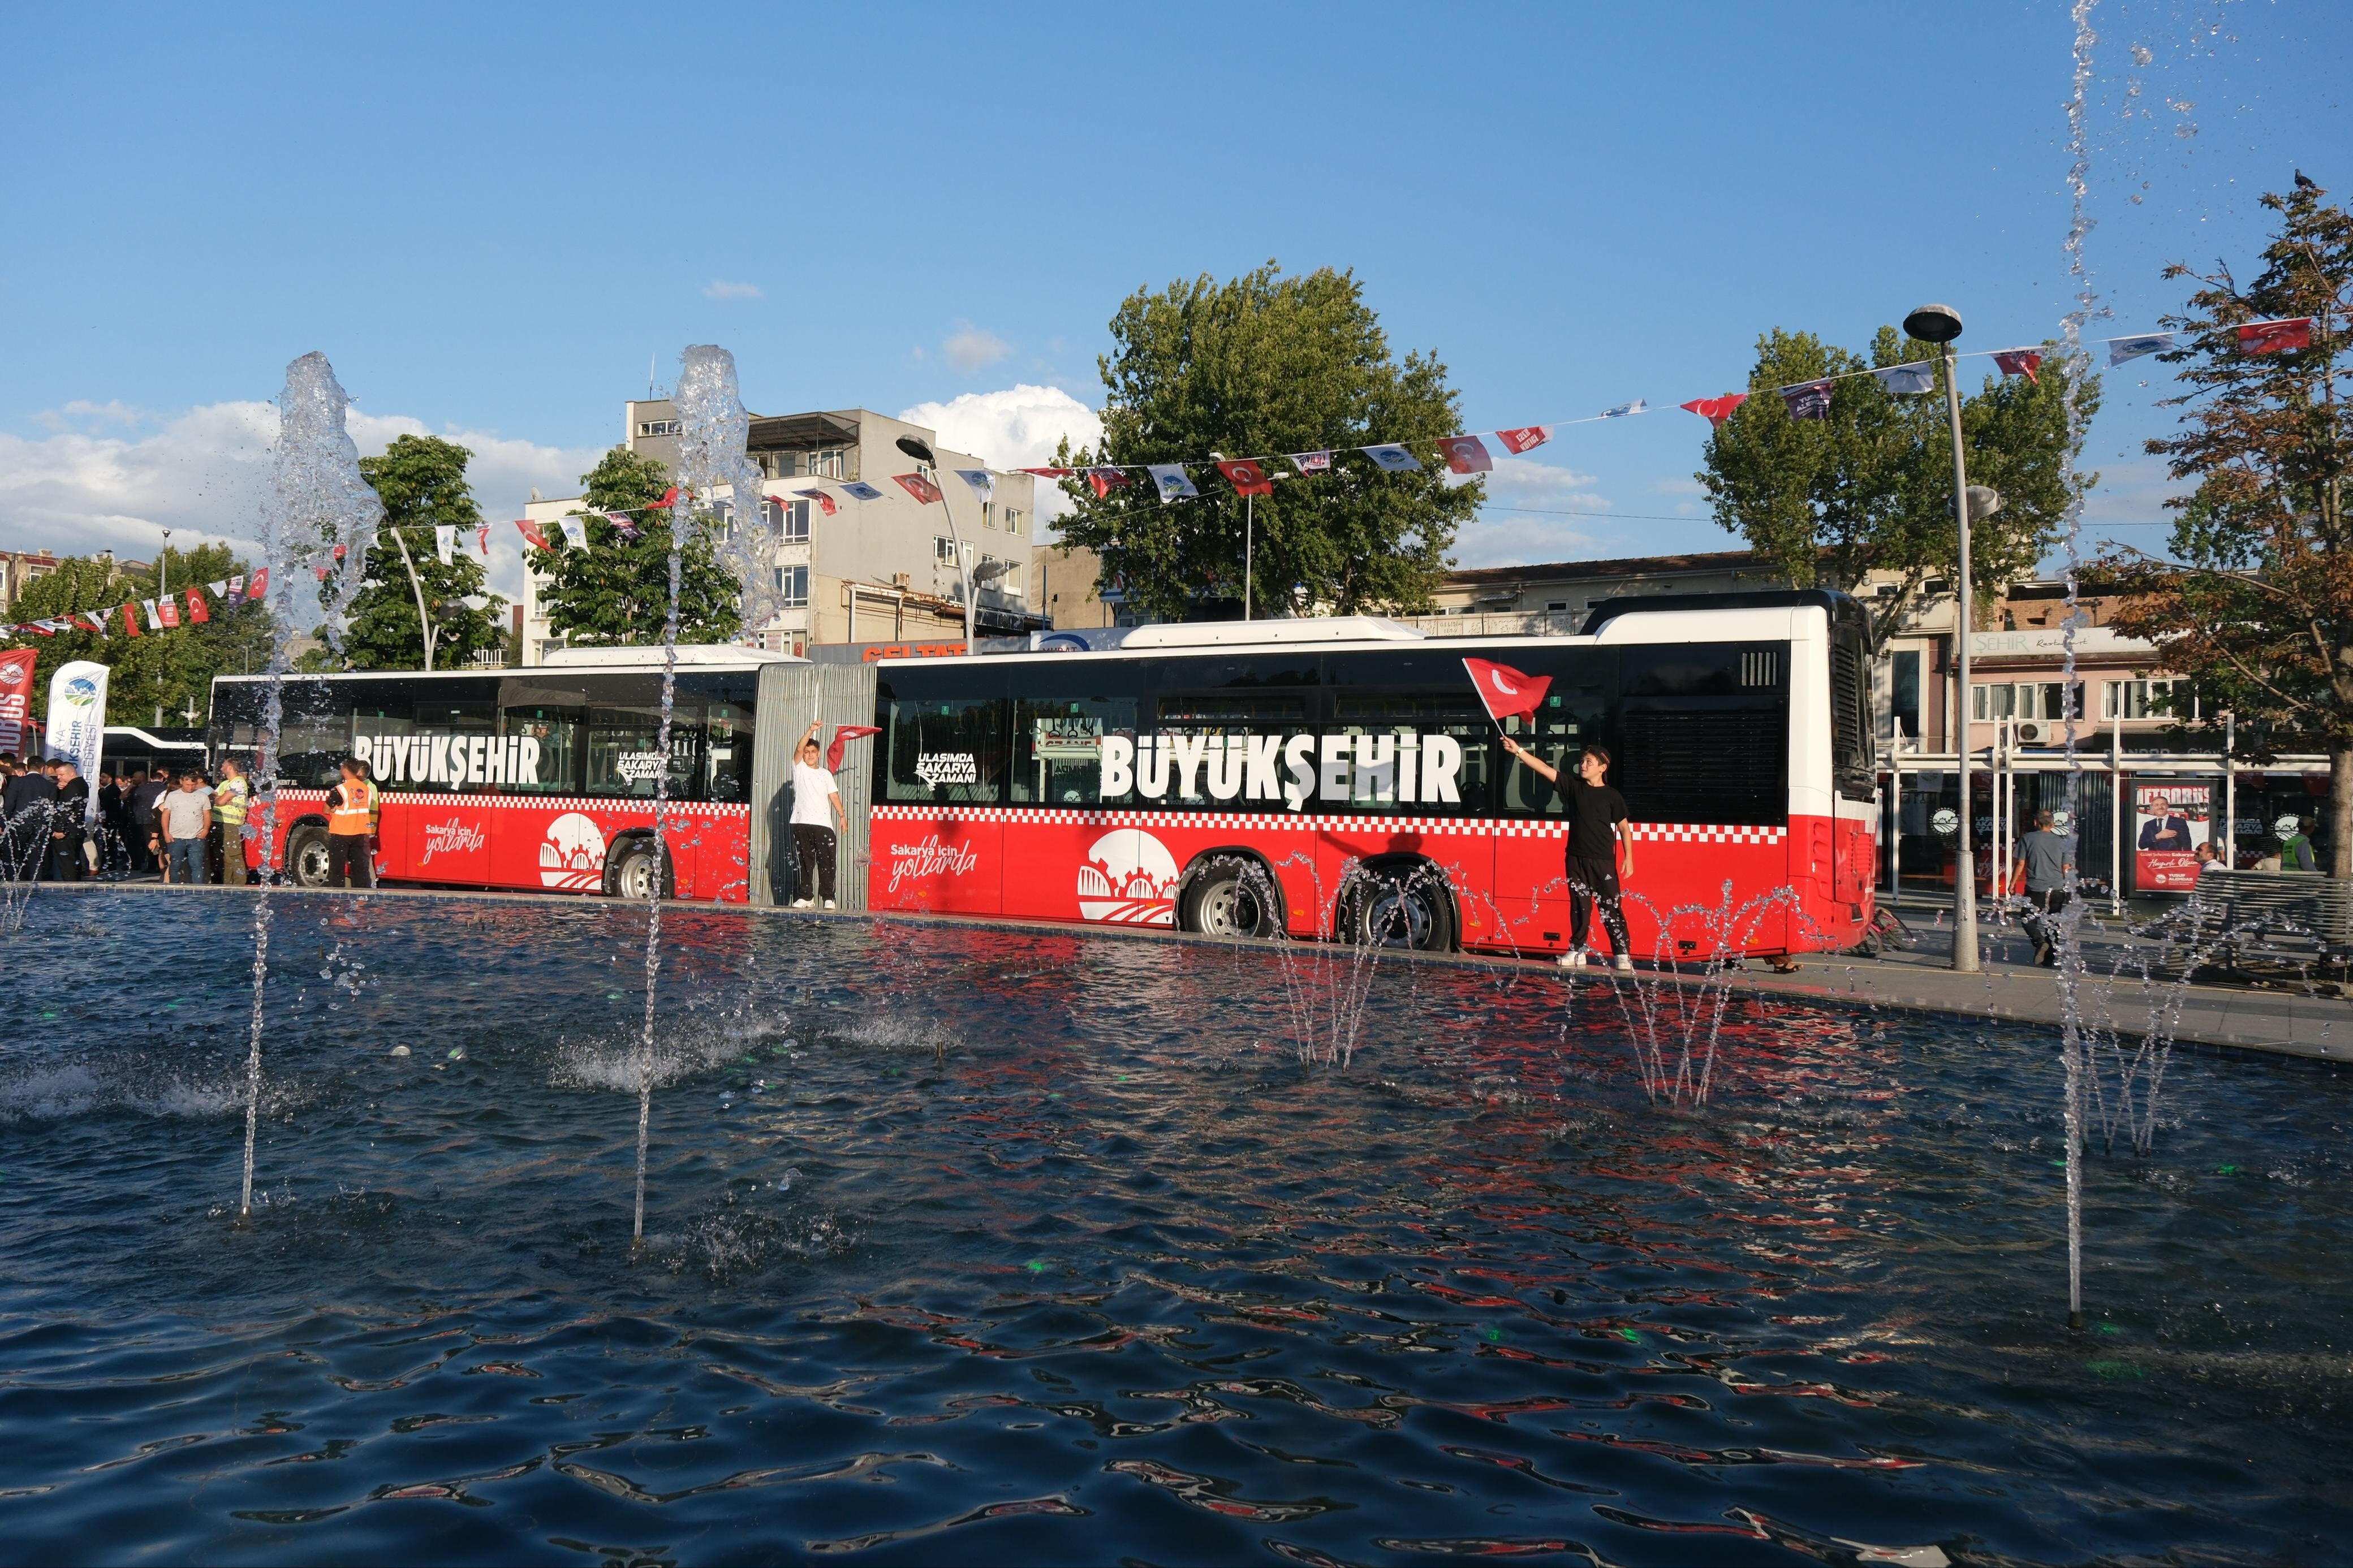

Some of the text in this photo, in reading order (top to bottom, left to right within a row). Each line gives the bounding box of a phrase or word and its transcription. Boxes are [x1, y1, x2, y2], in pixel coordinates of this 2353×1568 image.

[355, 735, 540, 791] BÜYÜKŞEHİR
[918, 753, 974, 763] ULAŞIMDA
[916, 763, 977, 774] SAKARYA
[1101, 733, 1462, 812] BÜYÜKŞEHİR
[931, 773, 977, 783] ZAMANI
[425, 824, 472, 837] Sakarya için
[423, 817, 485, 865] yollarda
[890, 844, 958, 858] Sakarya için
[888, 834, 977, 893] yollarda
